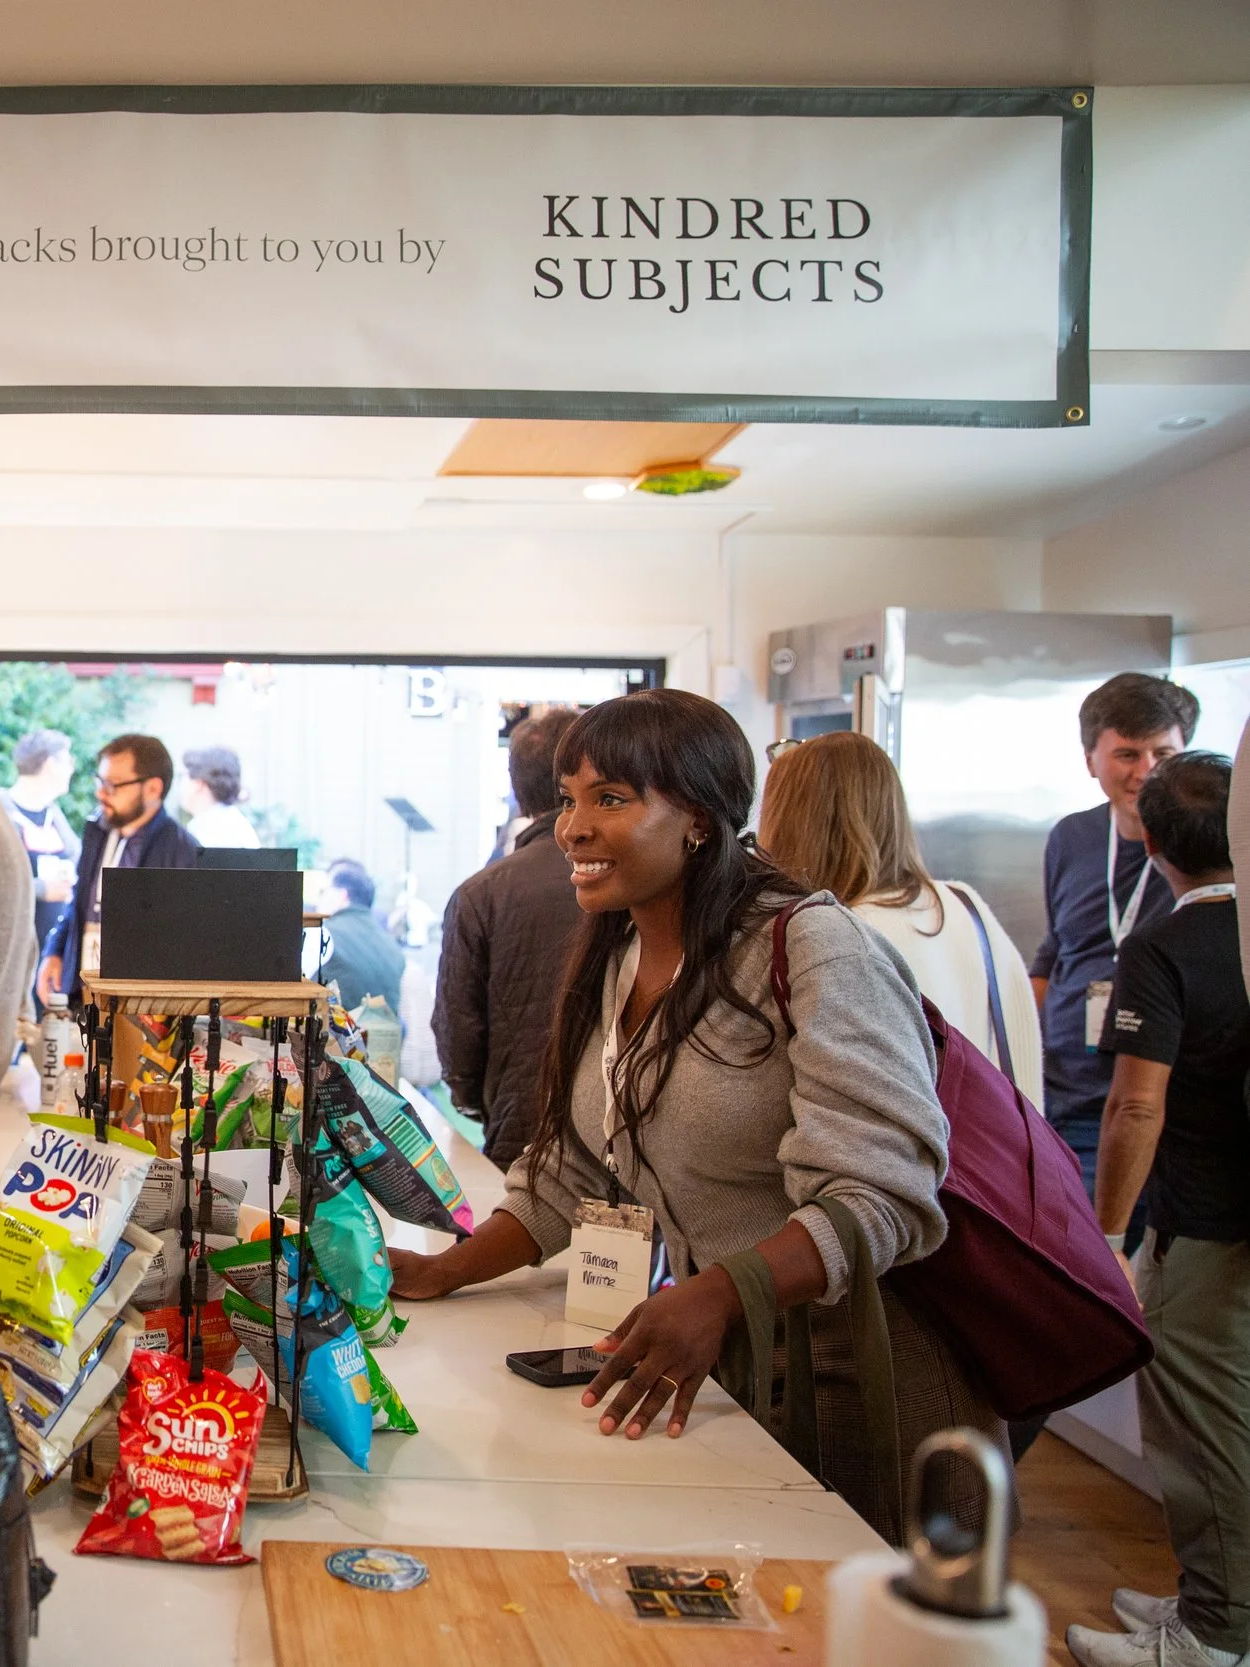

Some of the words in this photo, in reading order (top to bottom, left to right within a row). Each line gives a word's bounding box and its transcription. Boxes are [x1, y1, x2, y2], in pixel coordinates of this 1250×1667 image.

[543, 195, 870, 239] KINDRED
[90, 225, 247, 272] brought
[261, 233, 299, 263] to
[312, 240, 382, 273] you
[398, 228, 446, 275] by
[534, 257, 883, 313] SUBJECTS
[409, 667, 447, 718] B
[43, 1038, 58, 1078] Huel
[160, 1181, 173, 1189] 130
[3, 1216, 44, 1240] ORIGINAL
[4, 1229, 32, 1245] POPCORN
[228, 1266, 257, 1275] Nutrition
[145, 1332, 166, 1340] Facts
[331, 1338, 362, 1367] WHIT
[336, 1354, 368, 1380] CHEDDA
[142, 1410, 236, 1456] Sun
[171, 1437, 229, 1461] CHIPS
